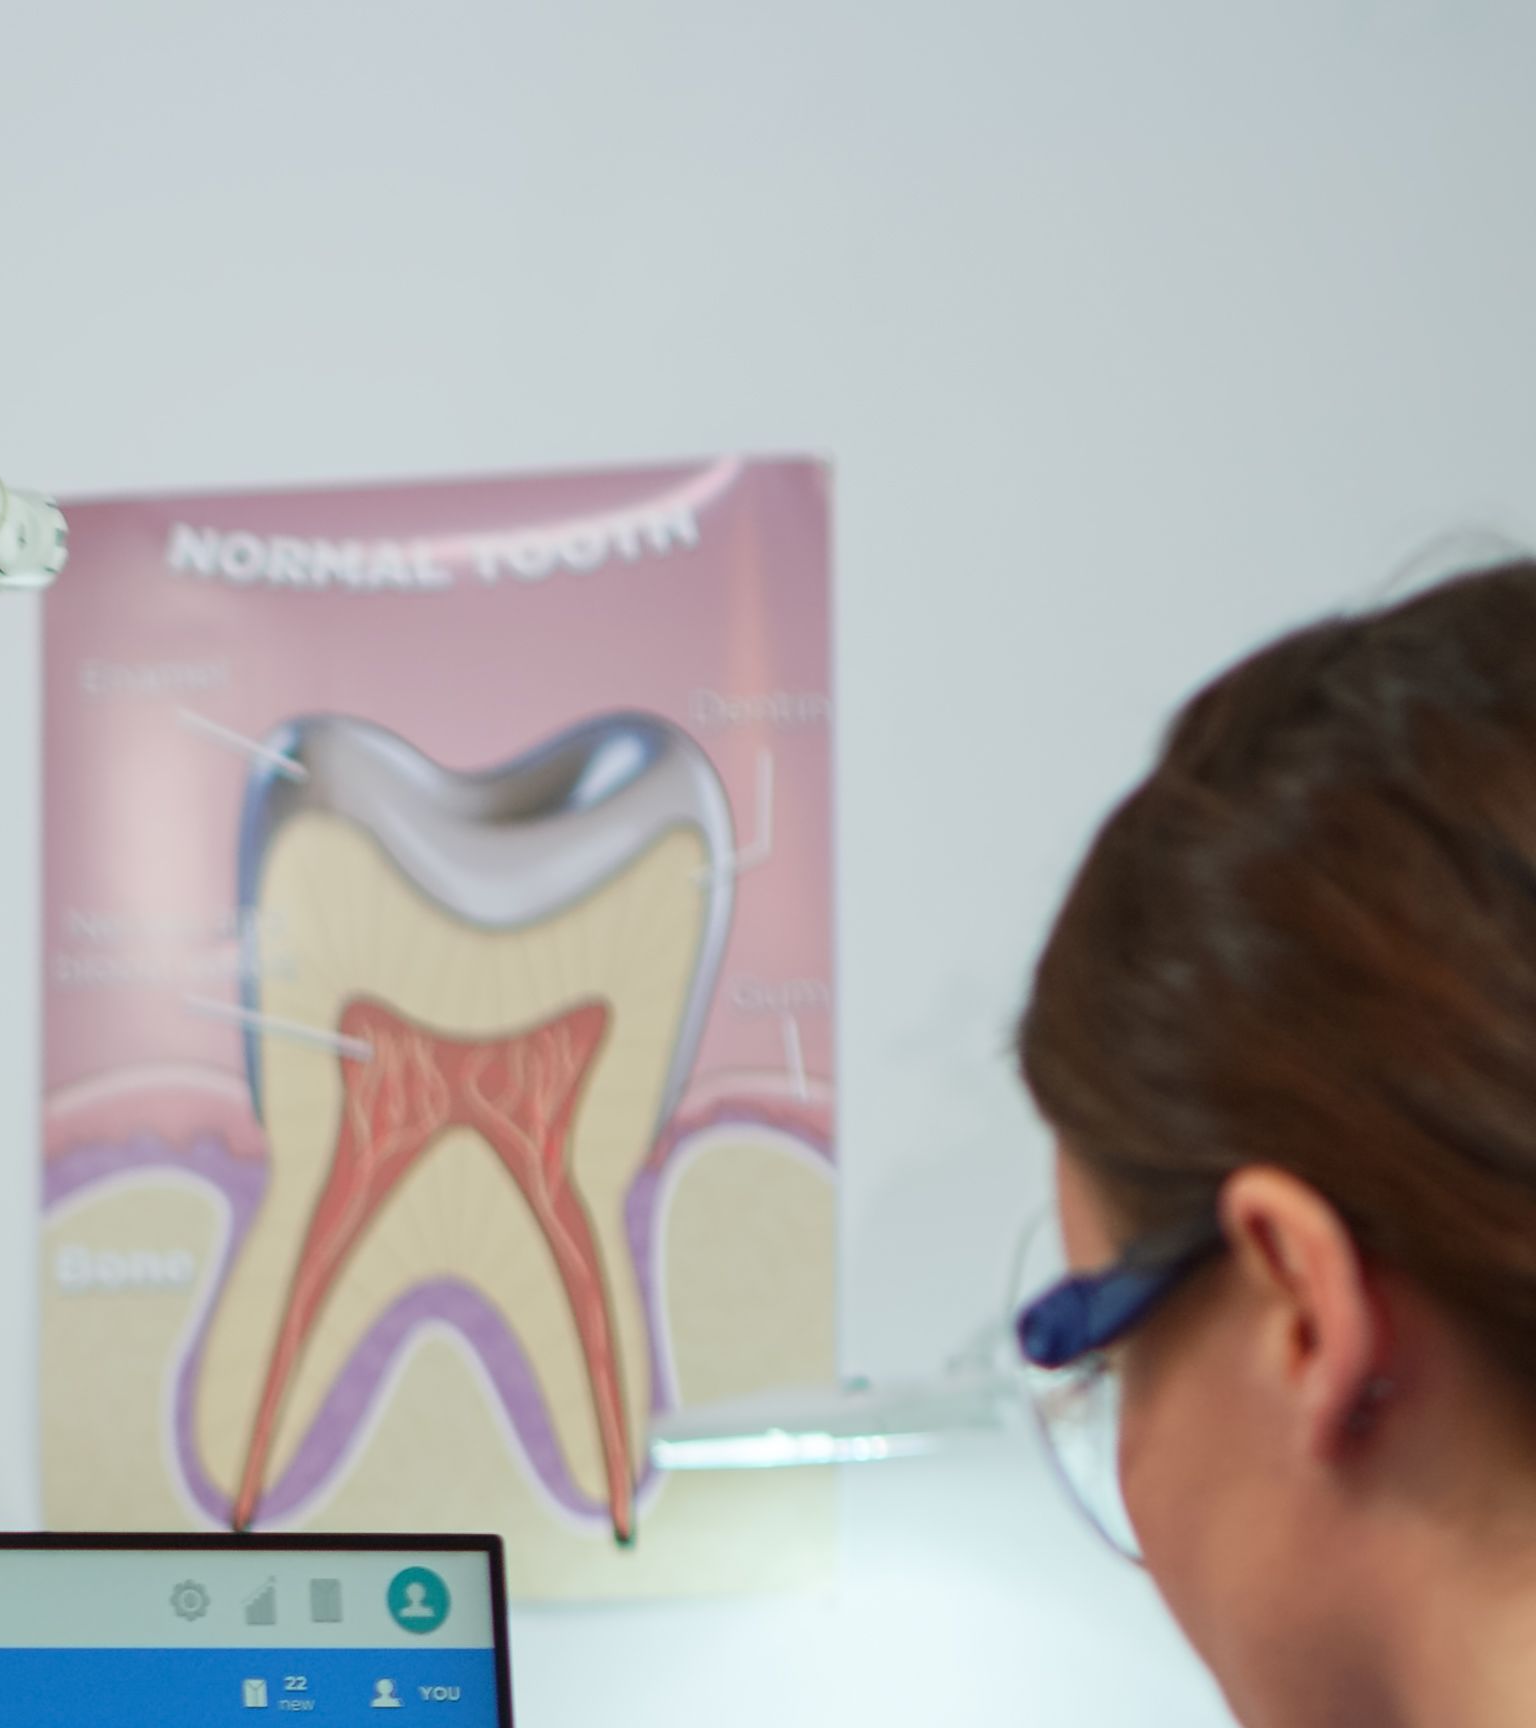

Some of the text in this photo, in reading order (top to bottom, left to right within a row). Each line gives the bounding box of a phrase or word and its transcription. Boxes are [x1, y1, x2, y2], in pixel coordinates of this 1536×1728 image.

[168, 507, 698, 590] NORMAL TOOTH
[283, 1675, 308, 1691] 22
[418, 1685, 461, 1701] YOU
[276, 1698, 316, 1711] new
